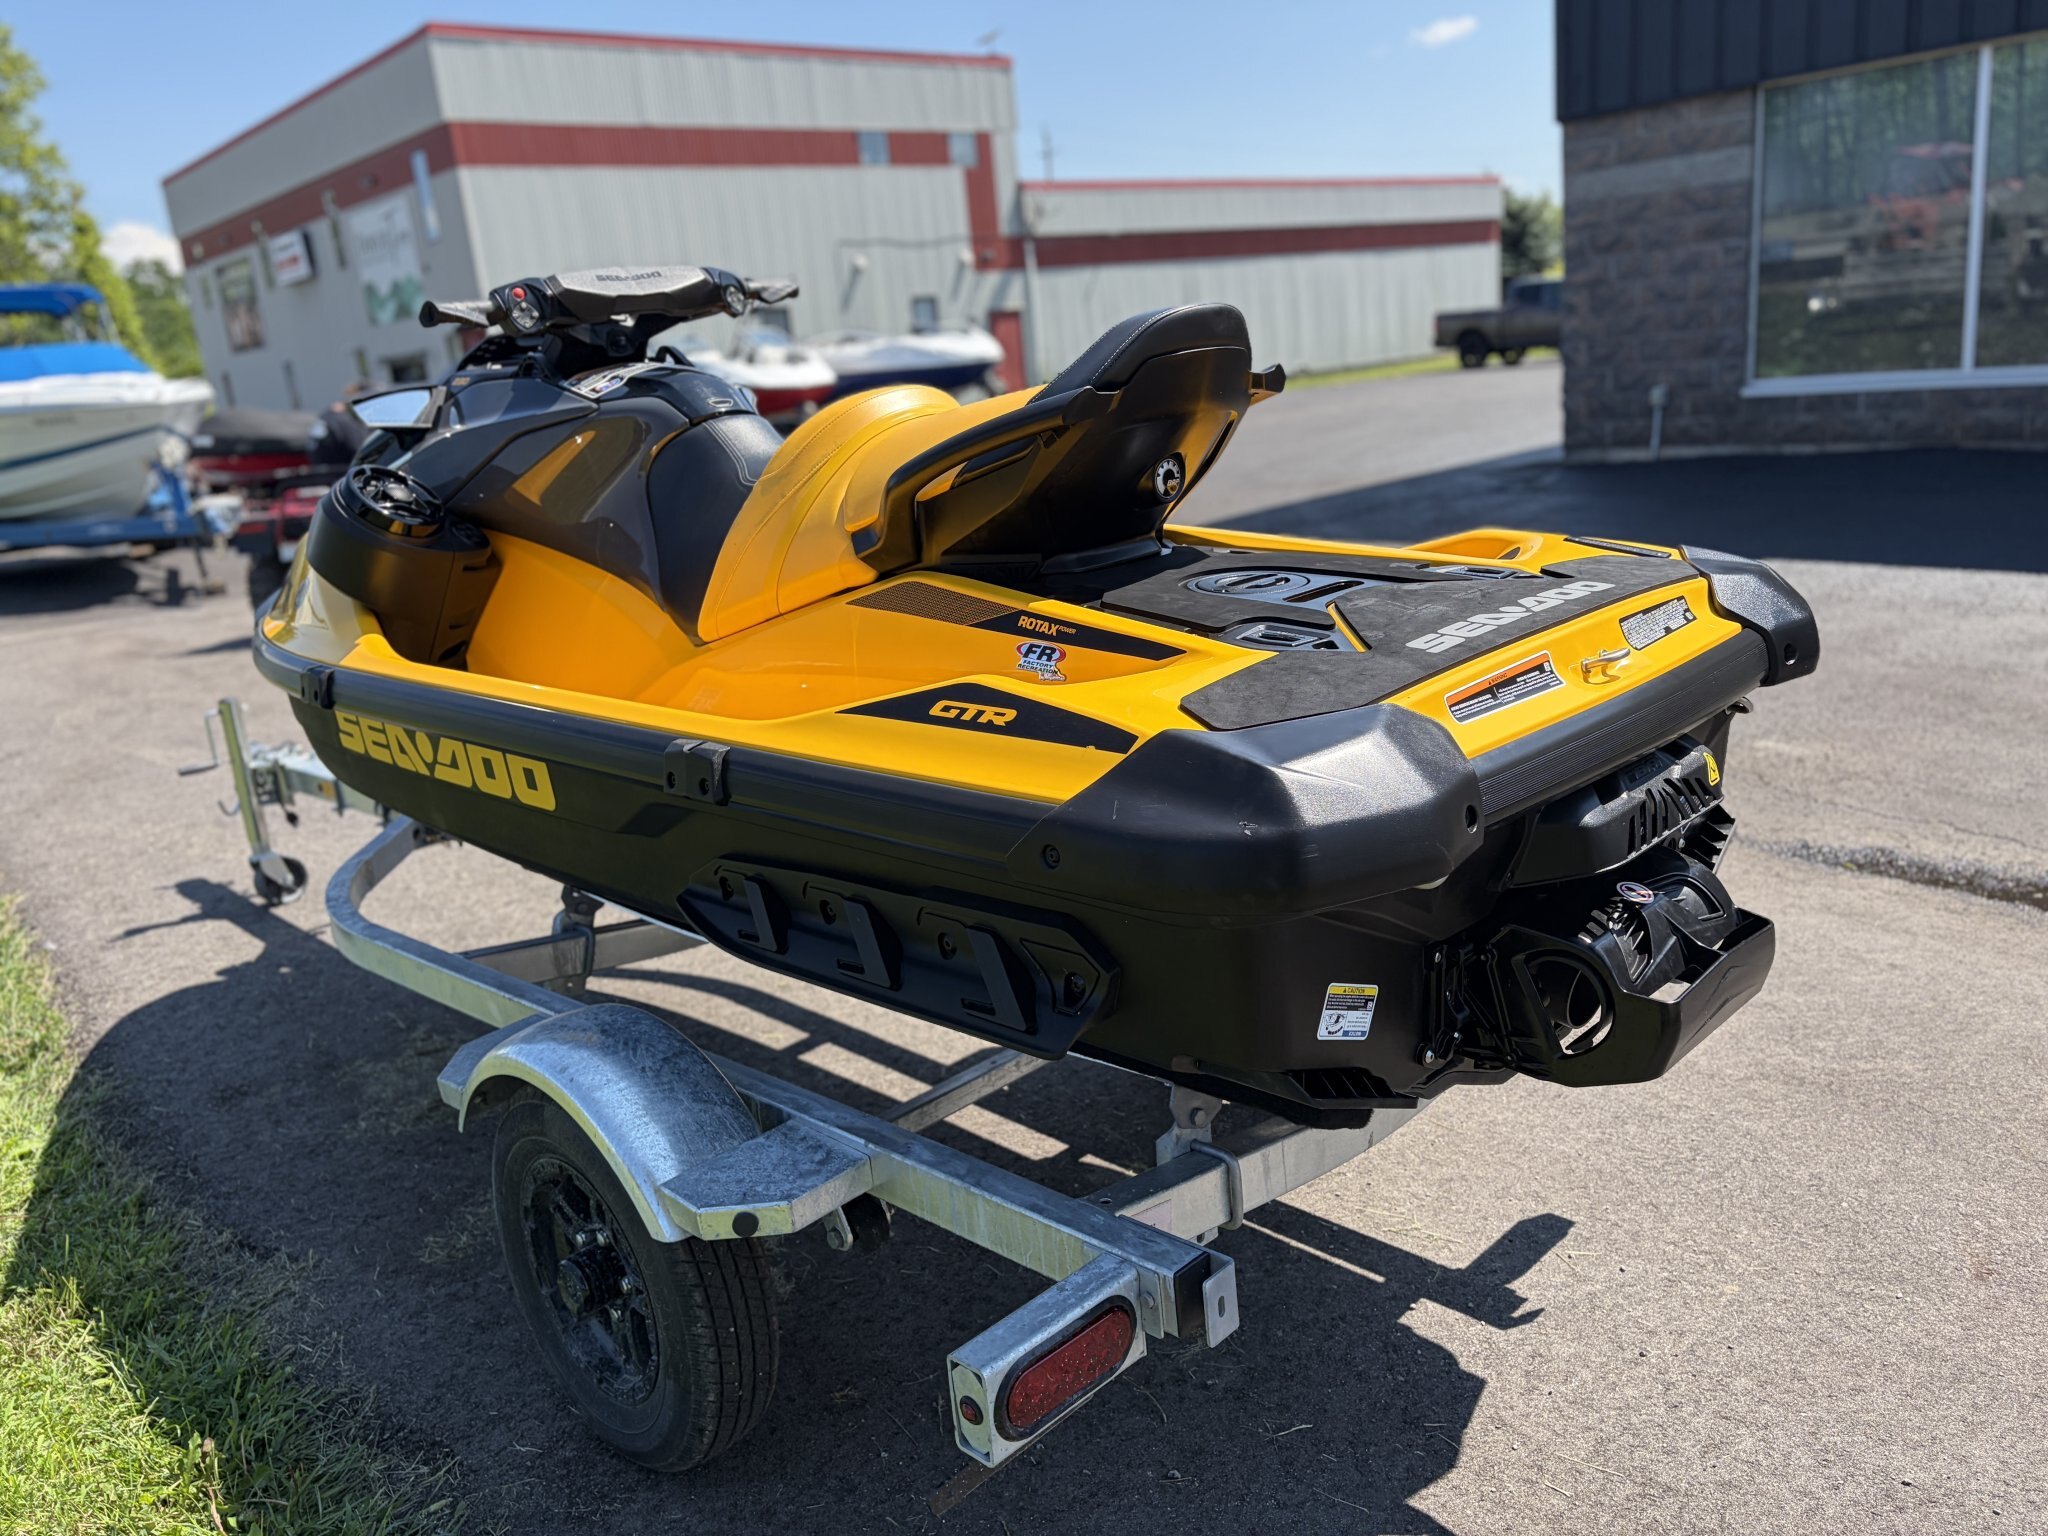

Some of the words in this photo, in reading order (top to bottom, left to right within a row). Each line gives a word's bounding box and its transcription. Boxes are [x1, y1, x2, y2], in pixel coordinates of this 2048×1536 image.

[1018, 615, 1060, 636] ROTAX
[1058, 625, 1077, 635] POWER
[1022, 643, 1057, 662] FR
[1017, 663, 1059, 675] RECREATION
[1023, 660, 1054, 669] FACTORY
[929, 700, 1018, 726] GTR
